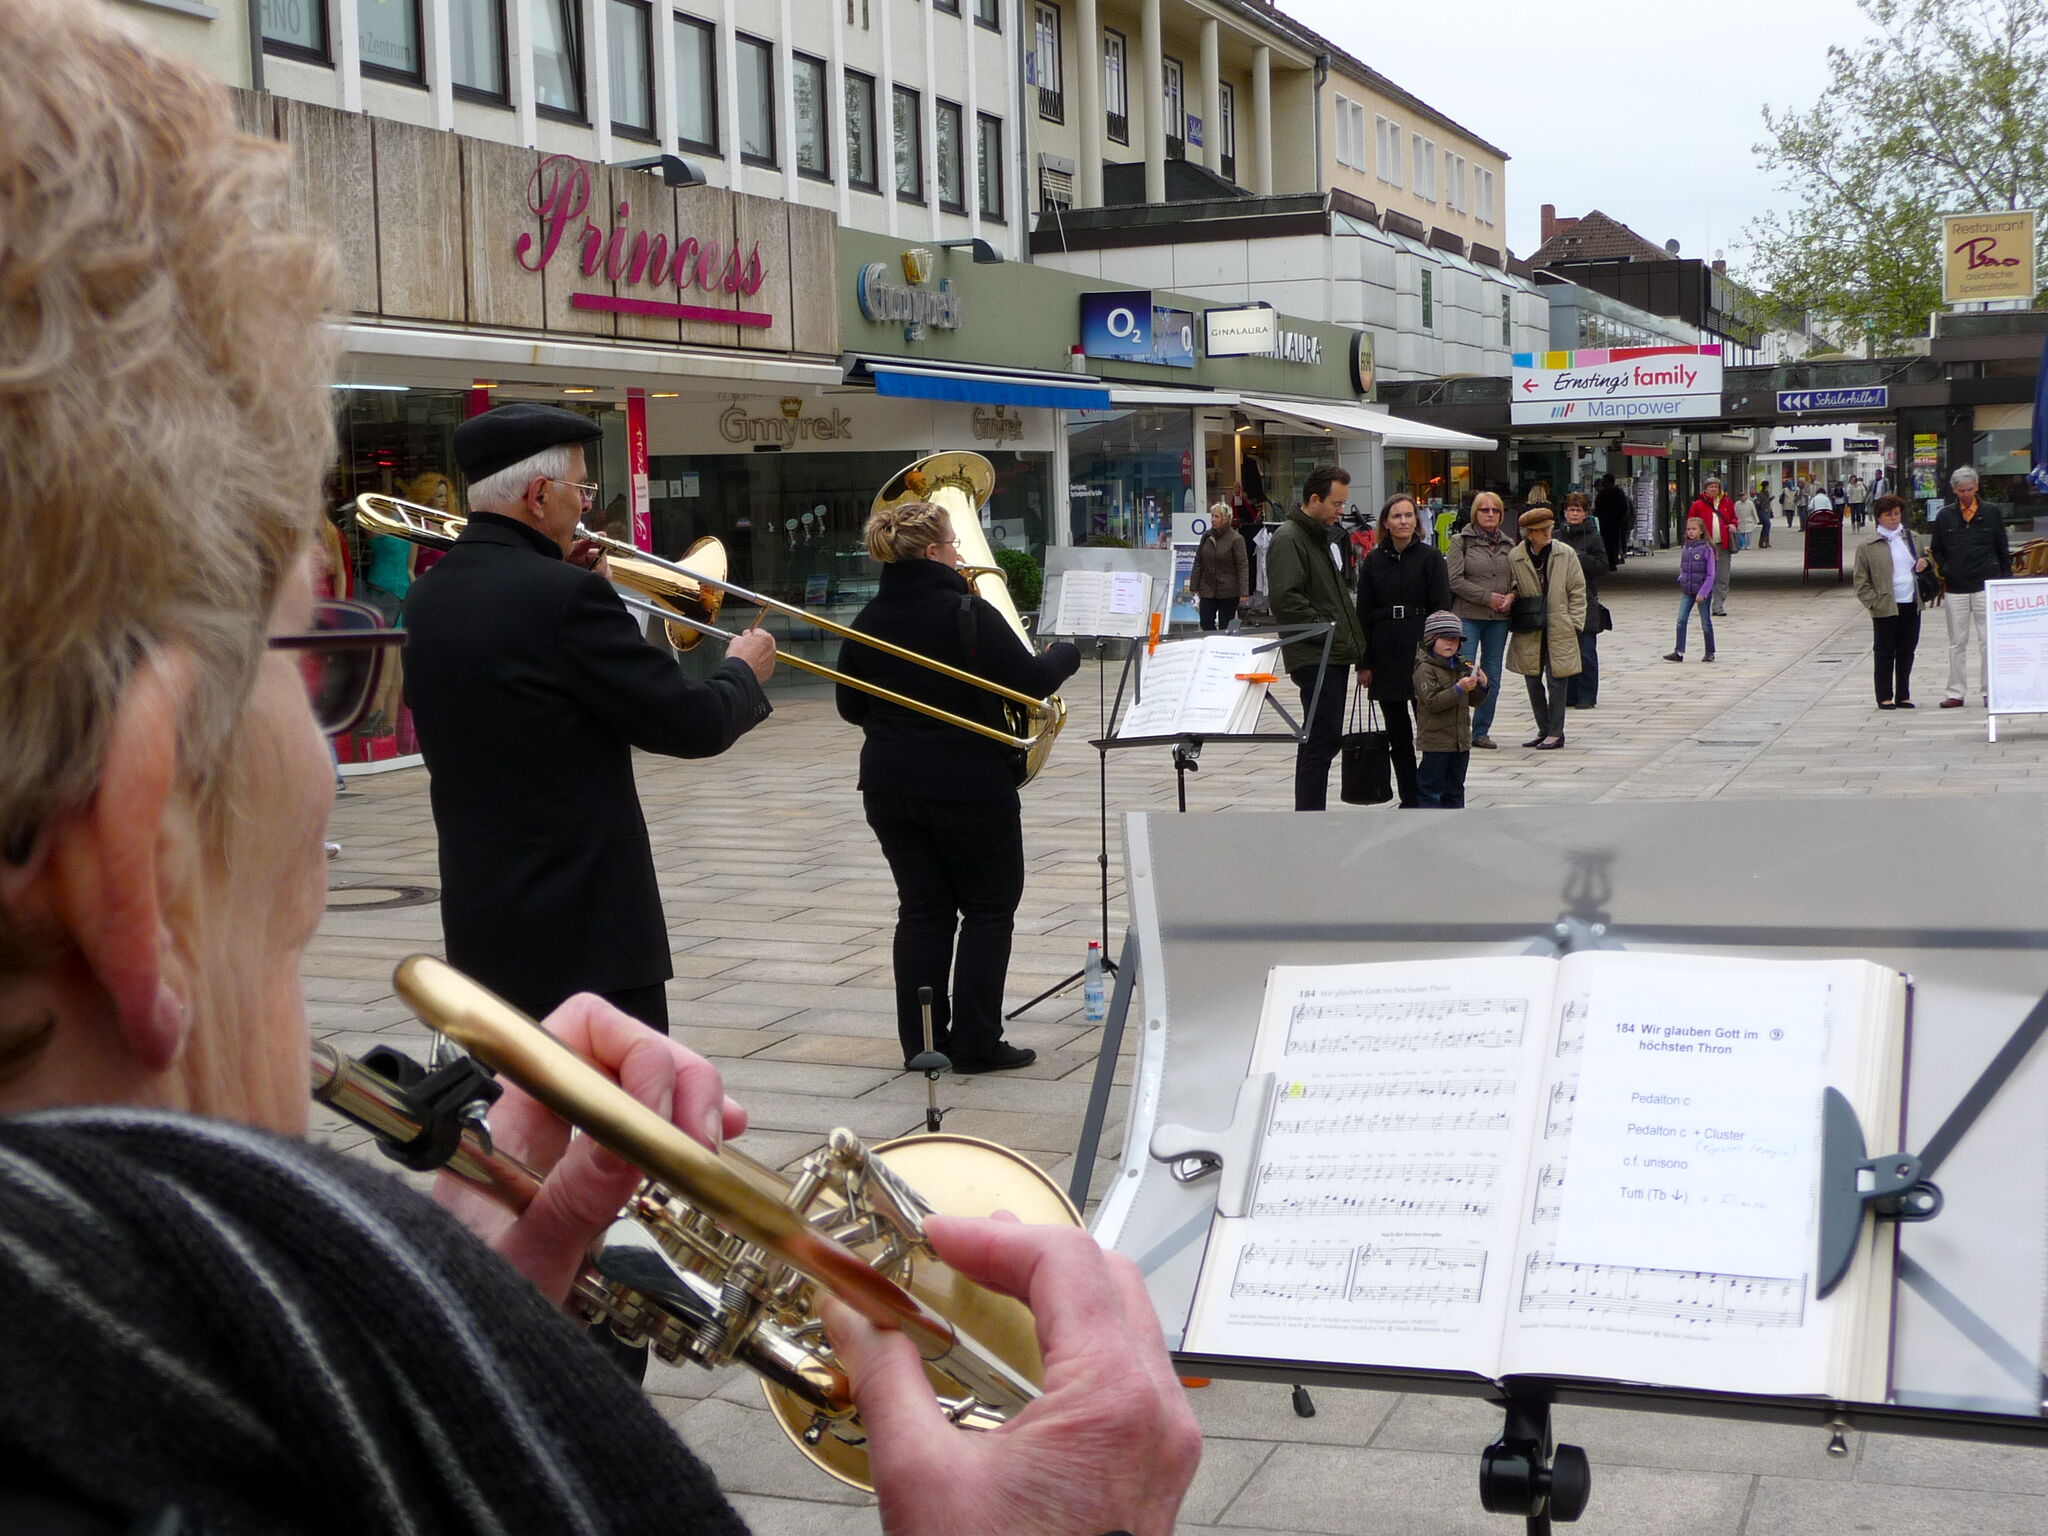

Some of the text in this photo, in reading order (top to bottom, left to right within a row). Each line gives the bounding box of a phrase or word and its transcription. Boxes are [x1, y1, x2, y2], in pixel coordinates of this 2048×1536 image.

[367, 31, 411, 63] Zentrum
[516, 153, 769, 297] Princess
[1952, 220, 2024, 234] Restaurant
[1953, 237, 2020, 270] Bao
[1211, 325, 1269, 337] GINALAURA
[1554, 363, 1698, 393] Ernsting's family
[1588, 401, 1682, 418] Manpower
[719, 407, 853, 449] Gmyrek
[1191, 518, 1207, 536] O
[1993, 595, 2048, 612] NEULA
[1299, 989, 1316, 998] 184
[1616, 1023, 1635, 1034] 184
[1641, 1024, 1661, 1036] Wir
[1664, 1026, 1711, 1038] glauben
[1715, 1027, 1741, 1040] Gott
[1744, 1030, 1759, 1040] im
[1639, 1040, 1733, 1055] höchsten Thron
[1631, 1092, 1691, 1106] Pedalton c
[1627, 1123, 1677, 1137] Pedalton
[1679, 1128, 1687, 1138] c
[1704, 1127, 1745, 1141] Cluster
[1623, 1155, 1688, 1169] c.f. unisono
[1620, 1186, 1667, 1202] Tutti (Tb
